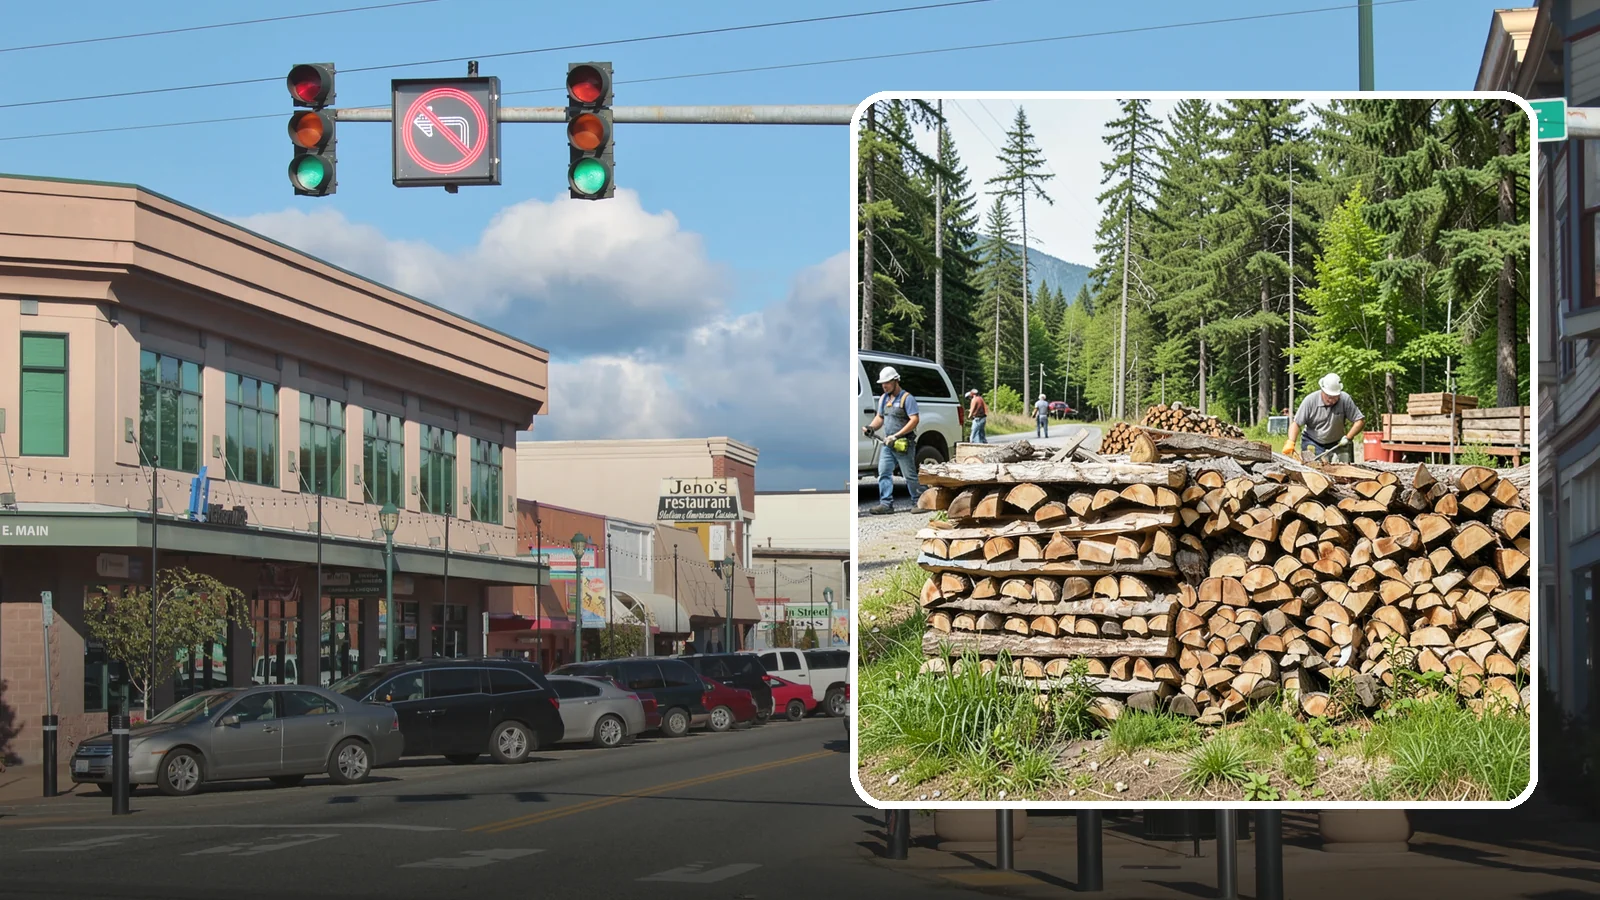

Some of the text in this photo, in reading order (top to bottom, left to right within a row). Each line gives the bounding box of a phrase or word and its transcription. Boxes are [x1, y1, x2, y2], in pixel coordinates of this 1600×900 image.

[669, 480, 727, 494] Jeno's
[665, 496, 731, 509] restaurant
[659, 510, 681, 519] Italian
[686, 510, 715, 519] American
[715, 510, 737, 519] Cuisine
[2, 525, 49, 536] E. MAIN
[797, 608, 828, 616] Street
